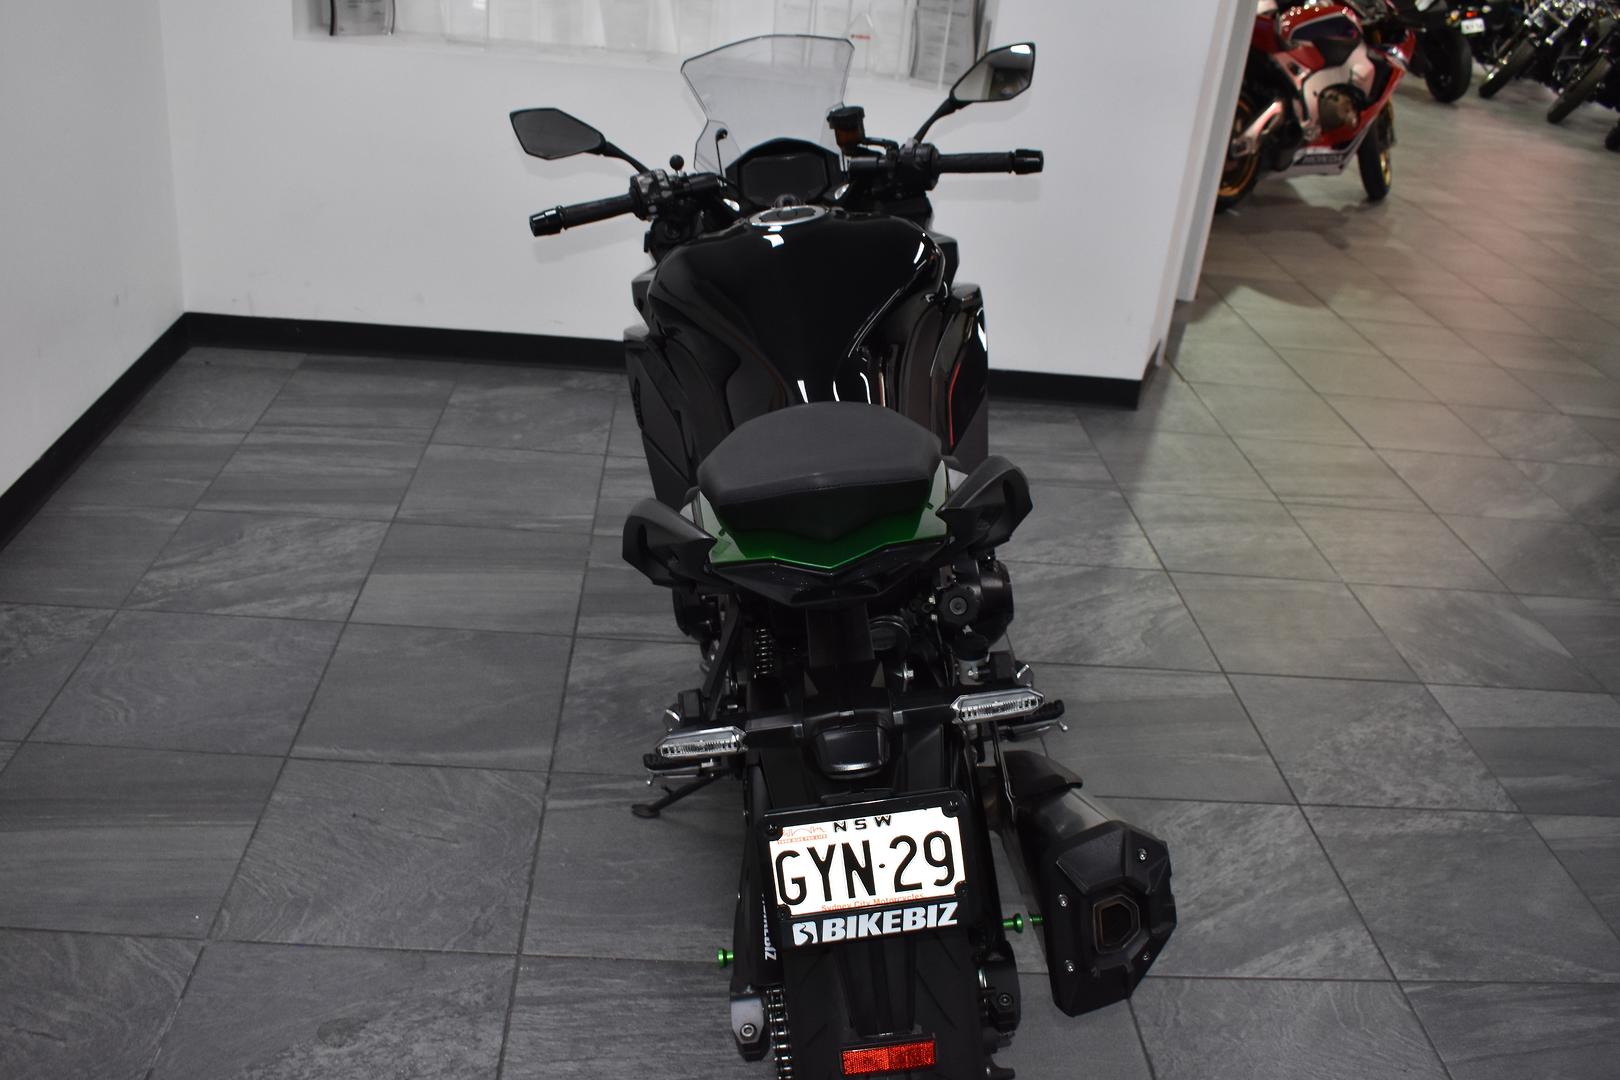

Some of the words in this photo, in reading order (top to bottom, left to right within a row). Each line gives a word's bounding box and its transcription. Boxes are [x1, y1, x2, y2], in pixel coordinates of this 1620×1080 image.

[833, 814, 892, 832] NSW
[821, 902, 851, 912] Sydney
[854, 900, 871, 909] City
[873, 893, 924, 907] Motorcycles
[821, 902, 958, 943] BIKEBIZ
